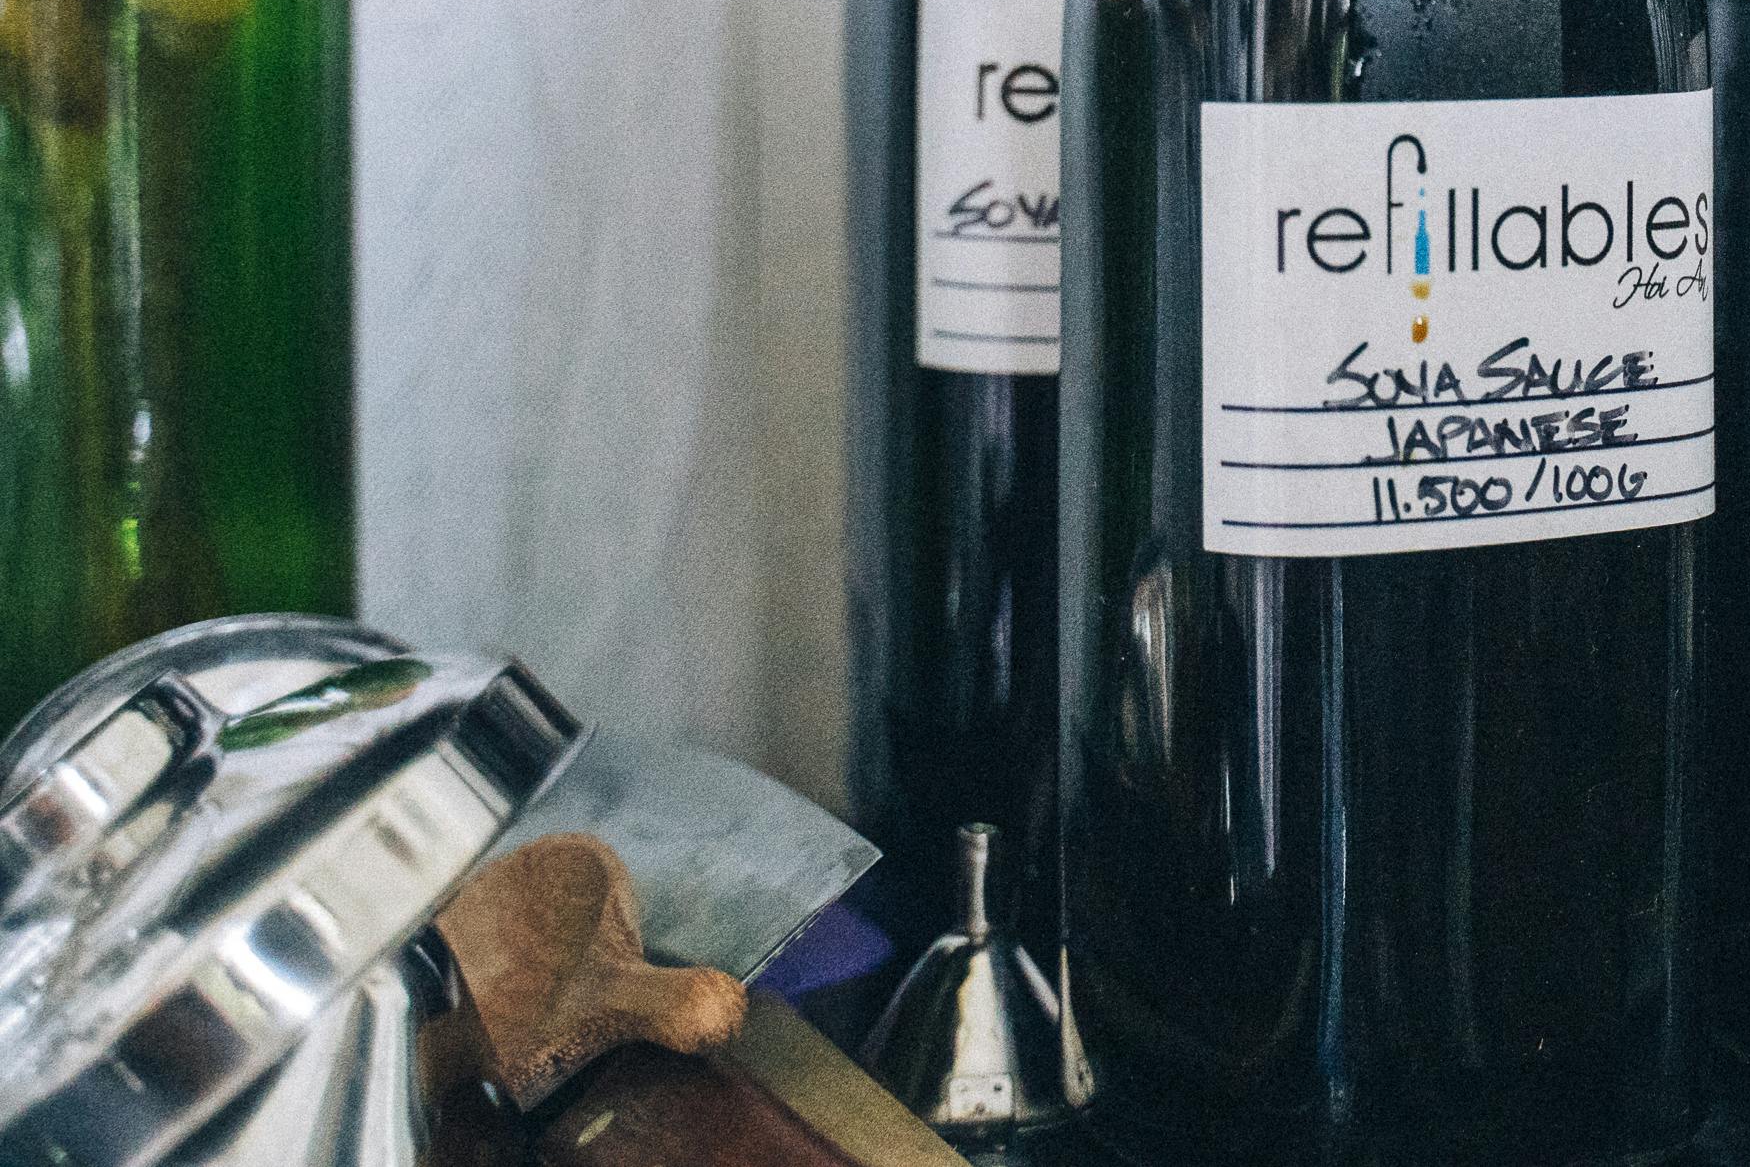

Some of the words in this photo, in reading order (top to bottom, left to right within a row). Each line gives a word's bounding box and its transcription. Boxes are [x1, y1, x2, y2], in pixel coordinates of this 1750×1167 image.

[1276, 134, 1709, 274] refillables
[1467, 337, 1659, 402] SAUCE
[1363, 405, 1639, 464] JAPANESE
